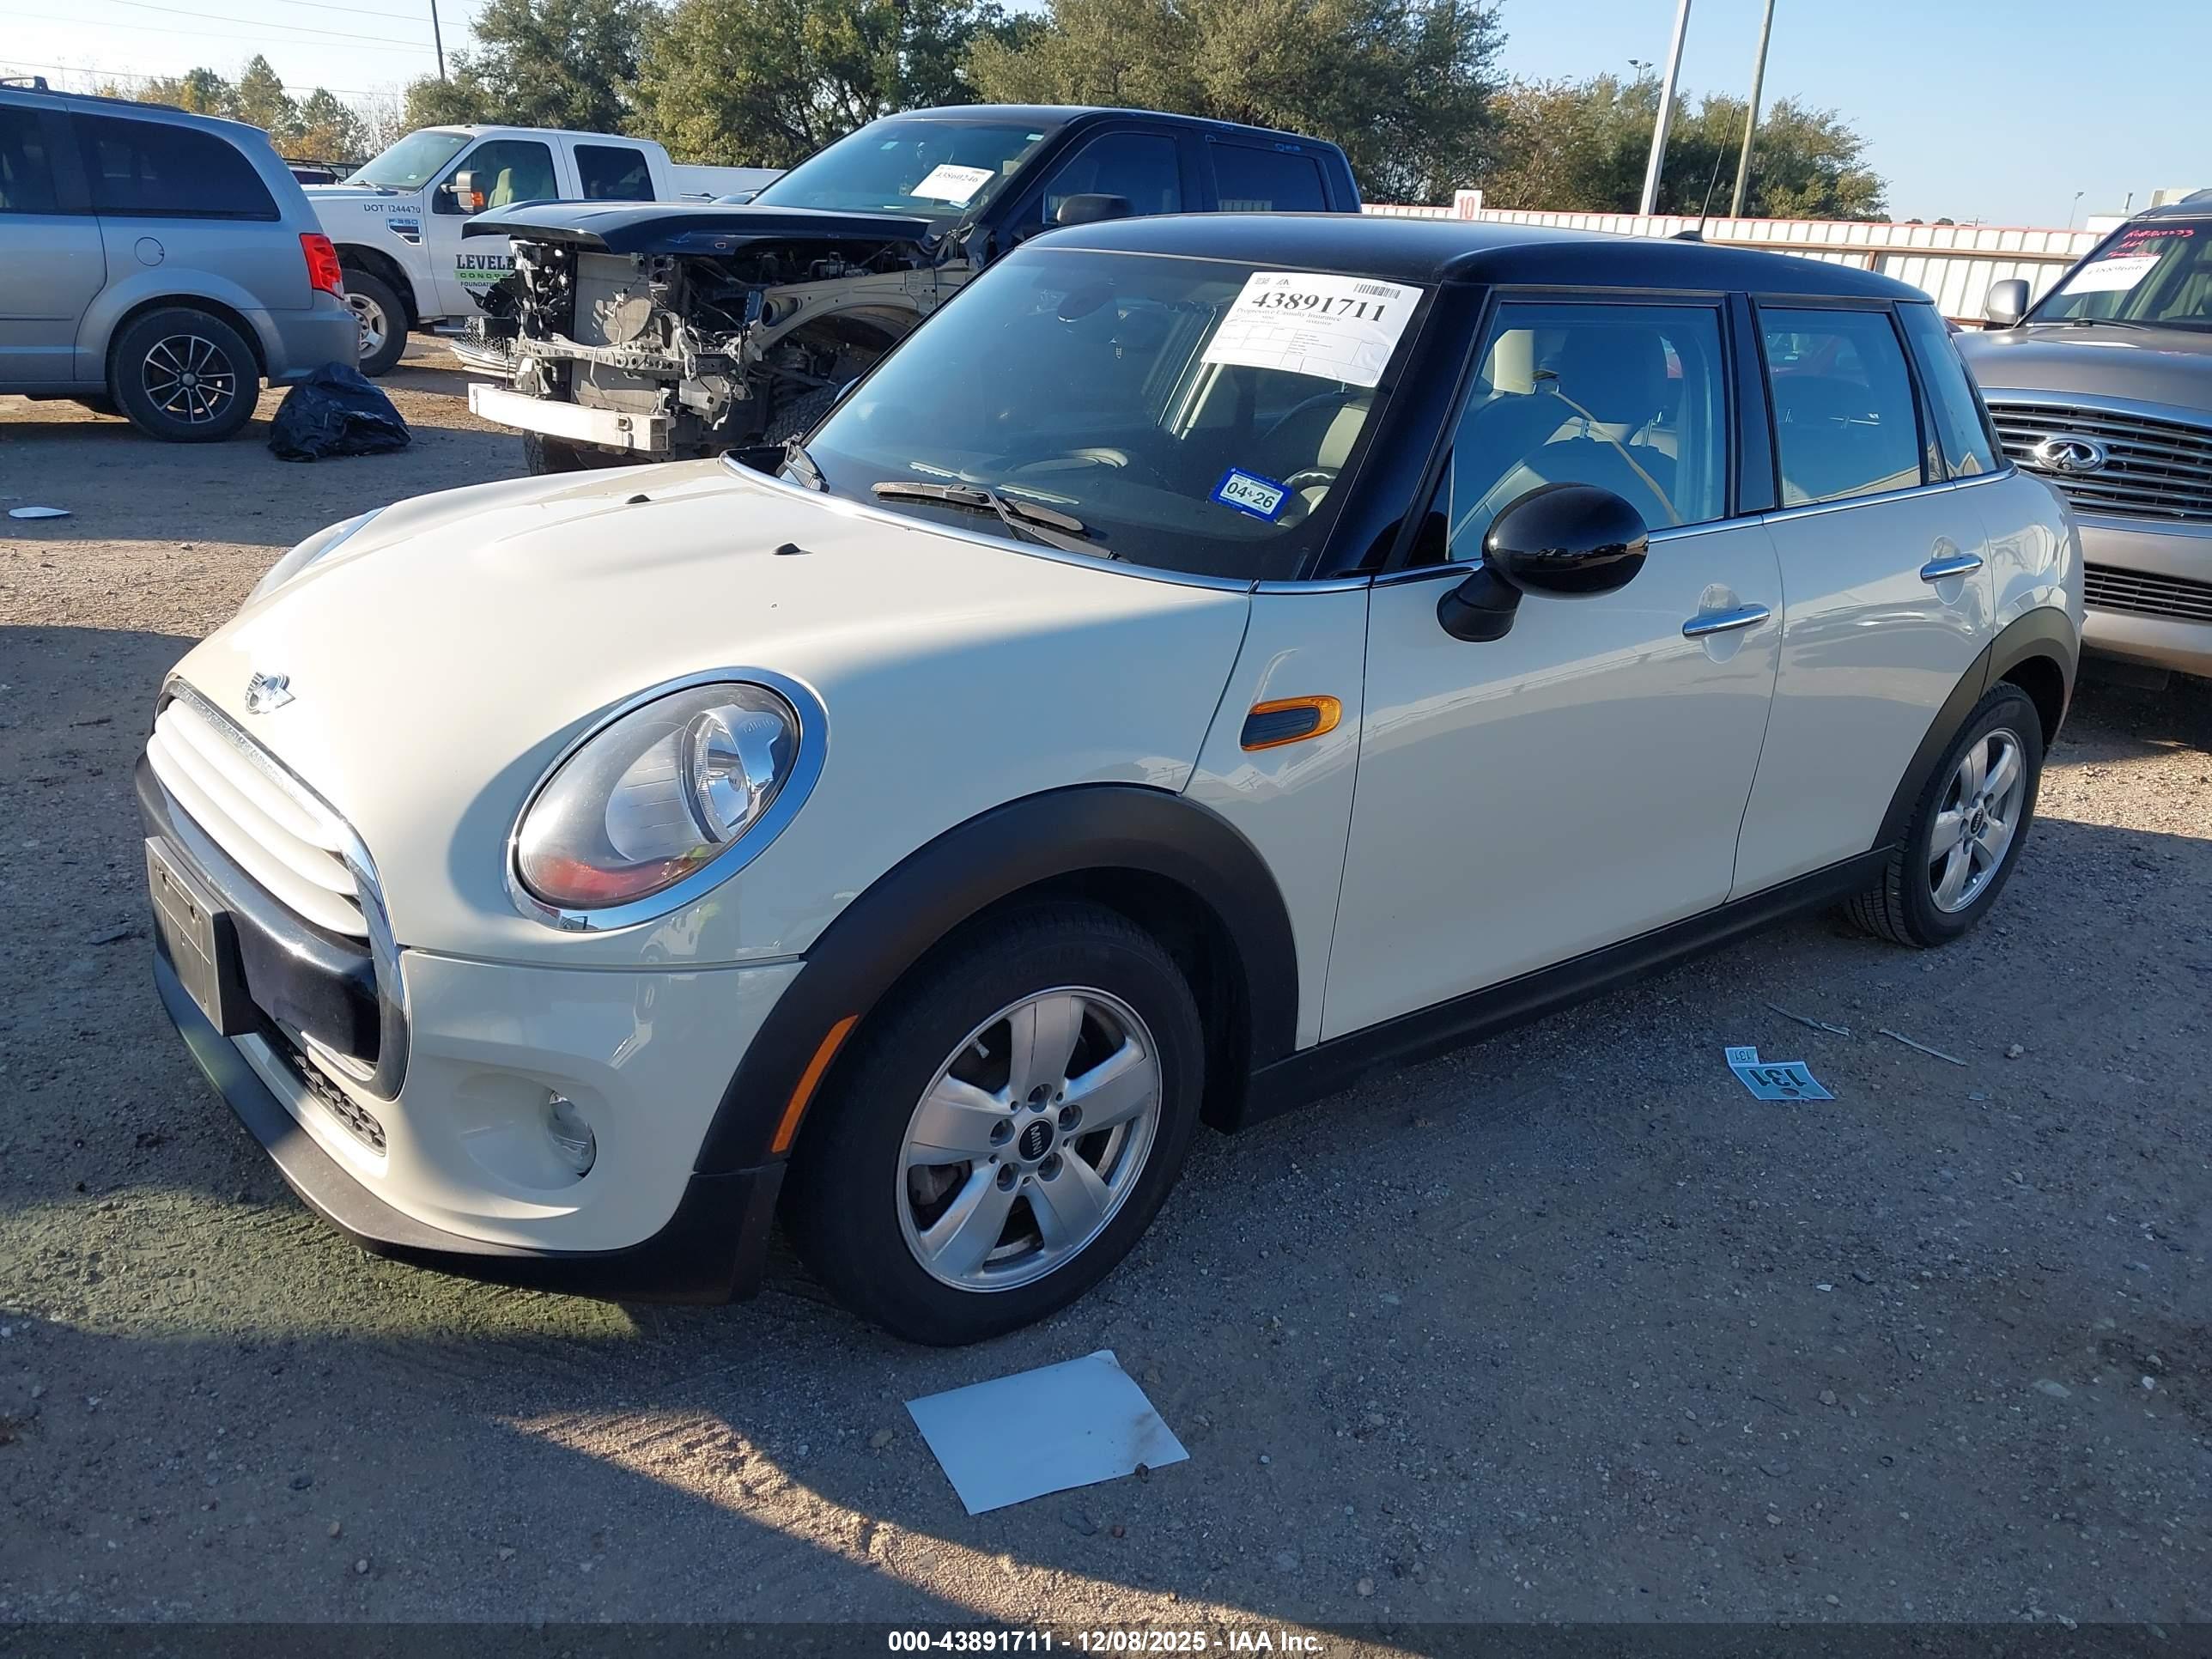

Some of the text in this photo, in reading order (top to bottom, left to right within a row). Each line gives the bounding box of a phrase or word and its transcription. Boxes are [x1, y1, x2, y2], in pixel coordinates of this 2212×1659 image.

[363, 204, 384, 212] DOT
[1459, 196, 1475, 220] 10
[1251, 291, 1387, 323] 43891711
[1226, 482, 1249, 498] 04
[1252, 492, 1275, 508] 26
[1748, 1068, 1807, 1086] 131
[1030, 1125, 1043, 1156] MINI
